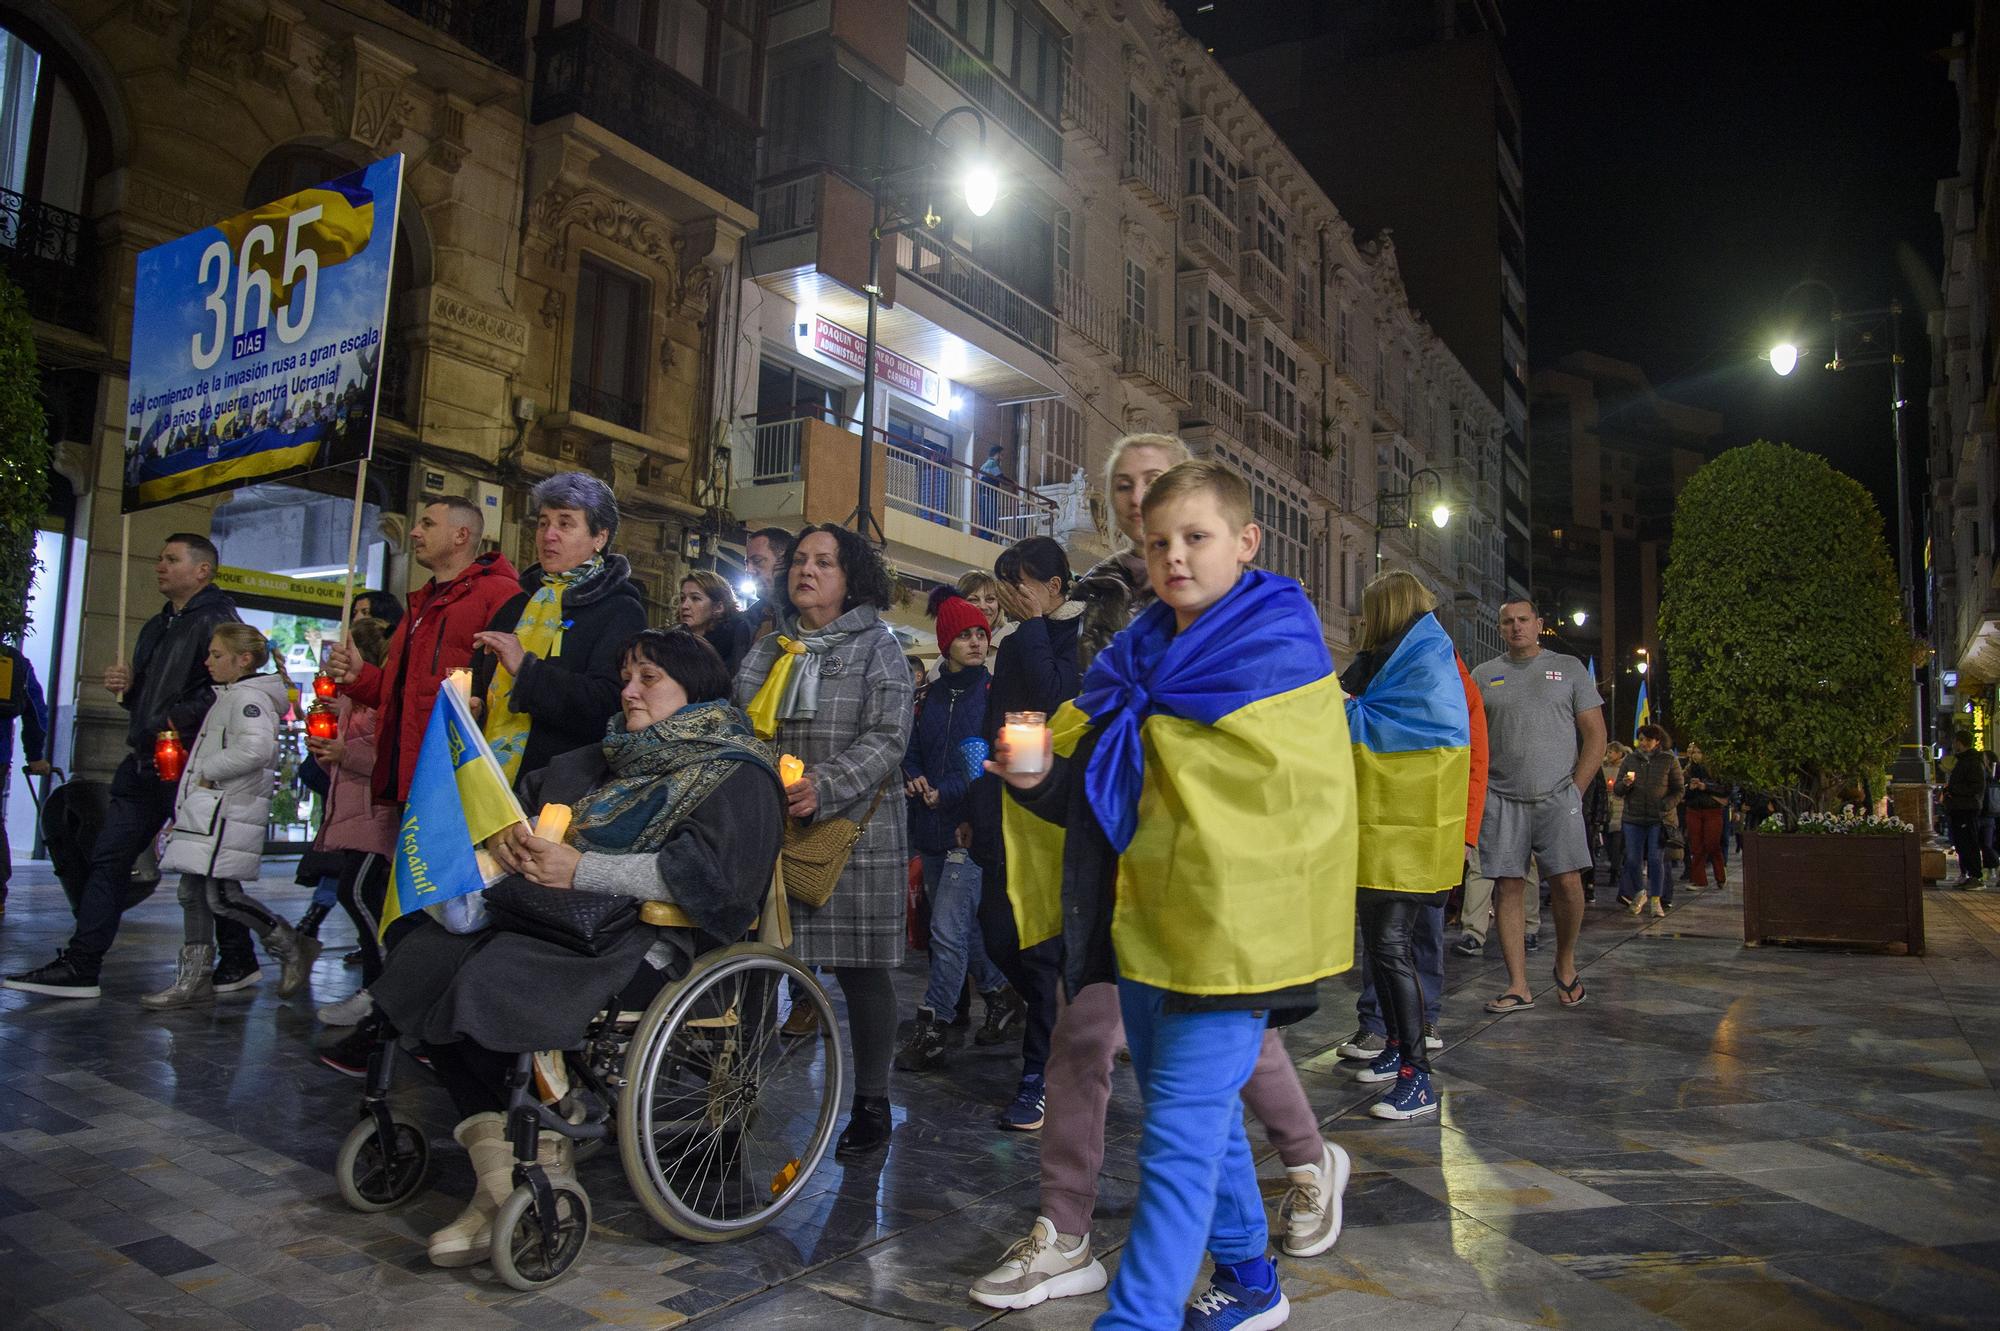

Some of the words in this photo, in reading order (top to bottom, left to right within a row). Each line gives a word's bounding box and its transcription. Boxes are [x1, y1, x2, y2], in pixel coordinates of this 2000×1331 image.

[191, 204, 324, 370] 365
[130, 396, 145, 415] del
[147, 386, 193, 411] comienzo
[196, 379, 209, 396] de
[212, 375, 221, 392] la
[224, 360, 268, 389] invasión
[272, 355, 296, 375] rusa
[300, 352, 307, 366] a
[310, 343, 336, 368] gran
[340, 327, 379, 354] escala
[235, 331, 262, 357] DÍAS
[818, 323, 852, 346] JOAQUIN
[855, 340, 895, 367] QUINERO
[897, 360, 921, 380] HELLIN
[820, 338, 879, 374] ADMINISTRACIOS
[887, 369, 910, 389] CARMEN
[164, 413, 172, 430] 9
[173, 409, 196, 427] años
[199, 403, 212, 420] de
[215, 394, 249, 420] guerra
[252, 383, 288, 405] contra
[216, 572, 242, 584] RQUE
[244, 577, 256, 586] LA
[259, 578, 288, 591] SALUD
[290, 583, 302, 593] ES
[304, 585, 315, 594] LO
[317, 587, 334, 598] QUE
[400, 815, 437, 896] Україні!
